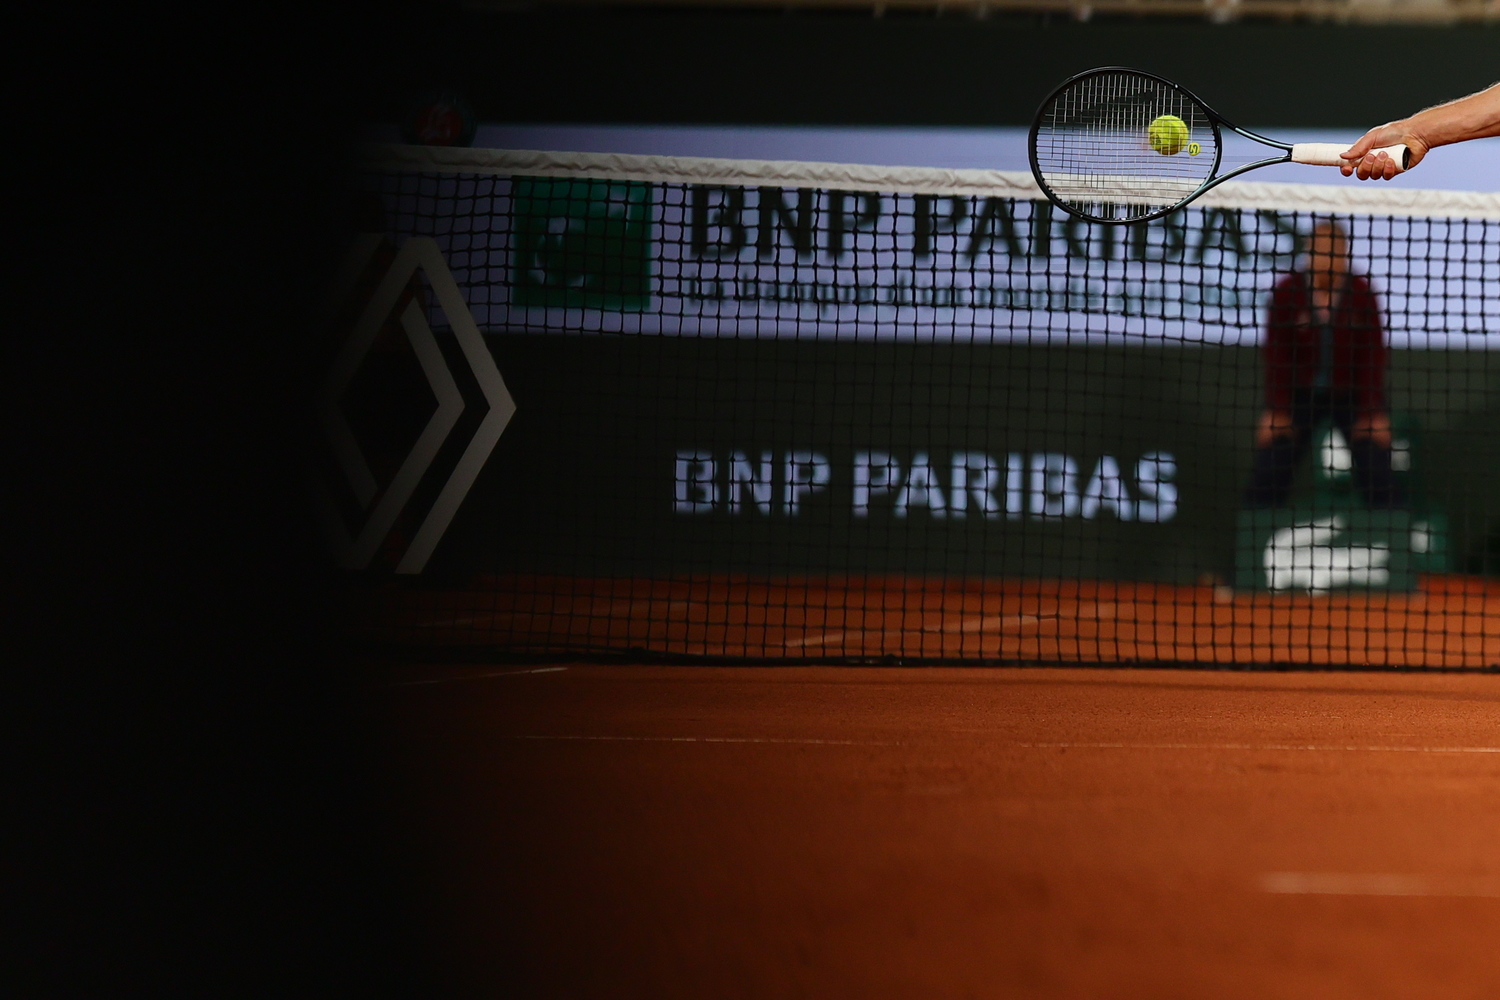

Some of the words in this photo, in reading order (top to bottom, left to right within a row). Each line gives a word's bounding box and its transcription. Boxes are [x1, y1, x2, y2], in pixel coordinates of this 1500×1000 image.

[690, 183, 881, 258] BNP
[914, 190, 1304, 263] PARIBAS
[674, 450, 831, 517] BNP
[852, 450, 1178, 523] PARIBAS
